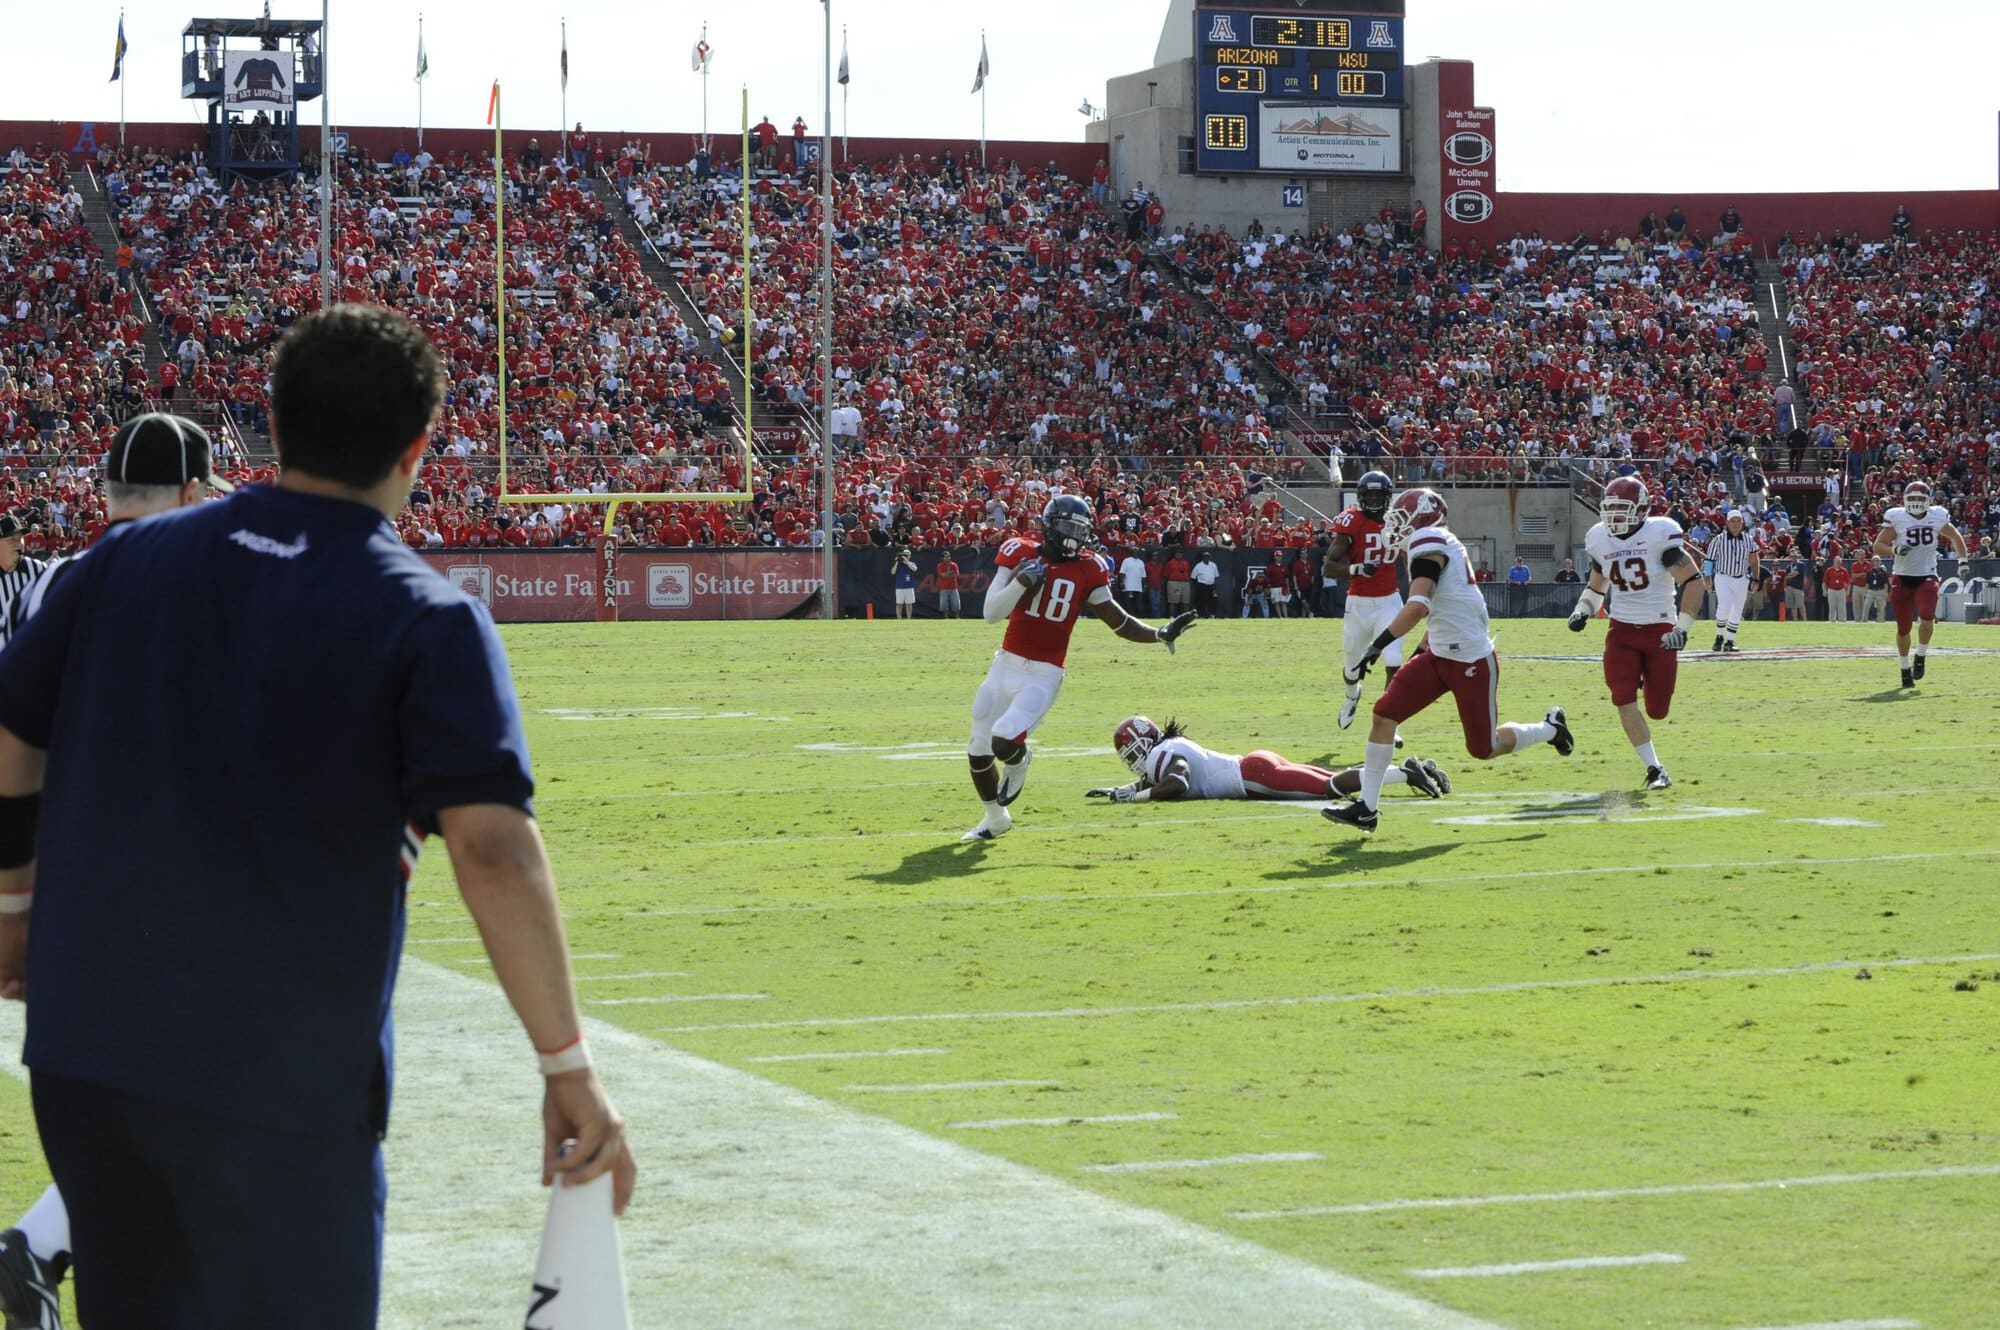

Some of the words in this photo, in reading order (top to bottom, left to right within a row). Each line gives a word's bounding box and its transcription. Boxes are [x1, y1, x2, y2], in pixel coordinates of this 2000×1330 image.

[1277, 19, 1348, 46] 2:18
[1217, 48, 1279, 65] ARIZONA
[1338, 52, 1368, 68] WSU
[1236, 69, 1263, 91] 21
[1284, 77, 1299, 87] QTR
[1311, 73, 1319, 91] 1
[1340, 73, 1365, 94] 00
[1446, 110, 1463, 119] John
[1465, 110, 1494, 119] "Button"
[1207, 117, 1245, 148] 00
[1456, 119, 1481, 129] Salmon
[328, 136, 347, 153] 12
[1302, 136, 1367, 147] Communications,
[1367, 138, 1382, 147] Inc.
[804, 145, 820, 164] 13
[1448, 168, 1489, 178] McCollins
[1456, 178, 1481, 187] Umeh
[1283, 189, 1303, 205] 14
[1463, 203, 1475, 212] 90
[1776, 476, 1784, 485] 14
[1785, 476, 1814, 485] SECTION
[1814, 476, 1822, 485] 15
[1906, 527, 1934, 547] 96
[603, 540, 617, 607] ARIZONA
[1609, 557, 1650, 591] 43
[495, 574, 558, 597] State
[694, 572, 755, 595] State
[1024, 578, 1076, 622] 18
